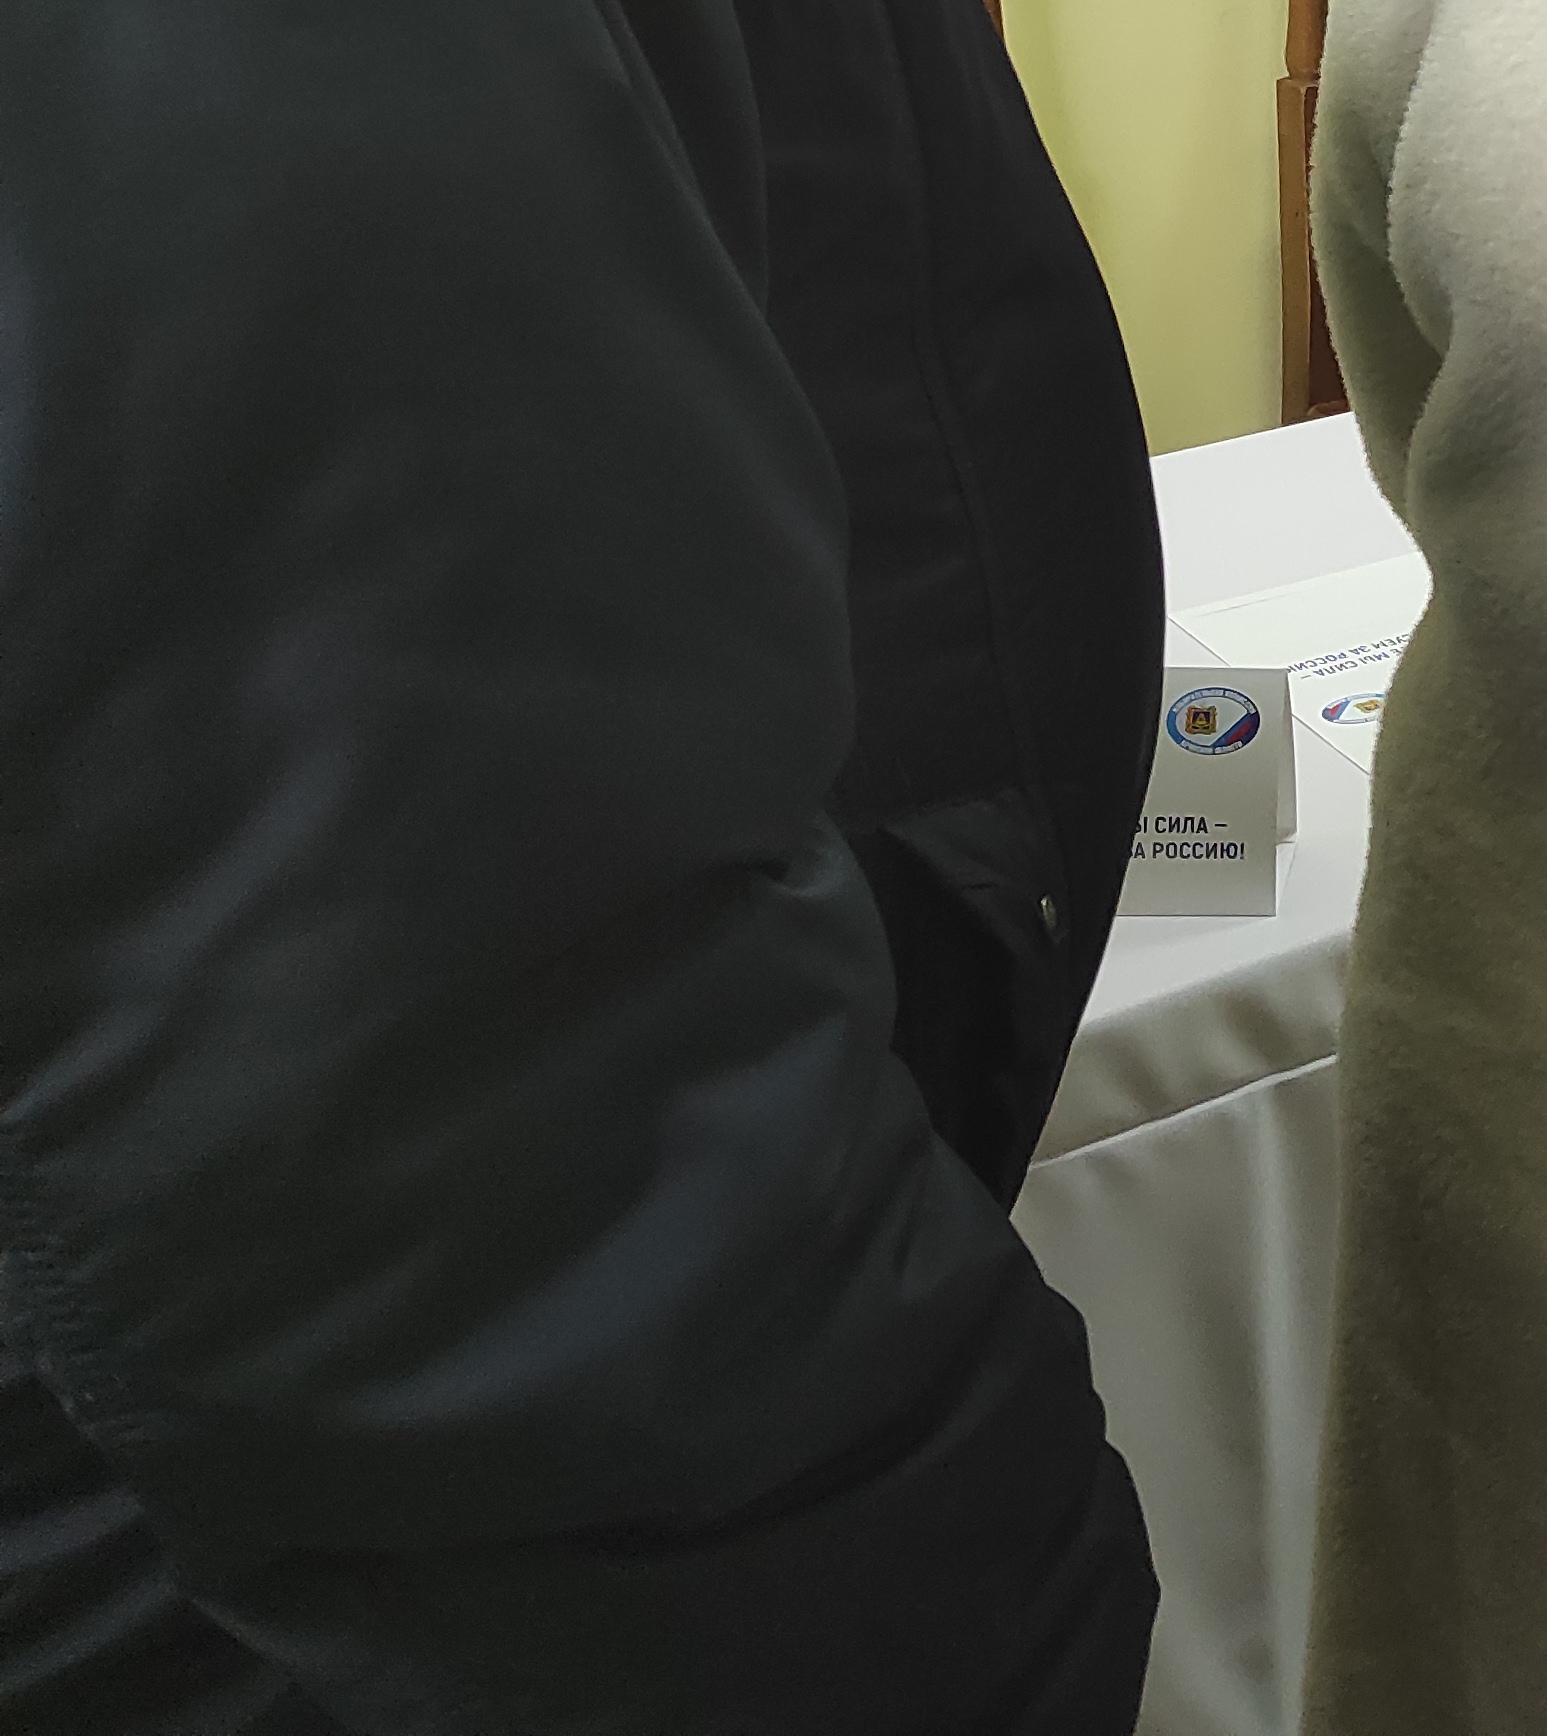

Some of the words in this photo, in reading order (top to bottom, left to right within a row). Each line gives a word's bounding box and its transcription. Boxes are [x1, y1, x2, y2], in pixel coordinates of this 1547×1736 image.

[1348, 645, 1371, 656] ЗА
[1360, 652, 1390, 664] МЫ
[1312, 660, 1358, 677] СИЛА
[1154, 816, 1208, 834] СИЛА
[1152, 842, 1245, 860] РОССИЮ!
